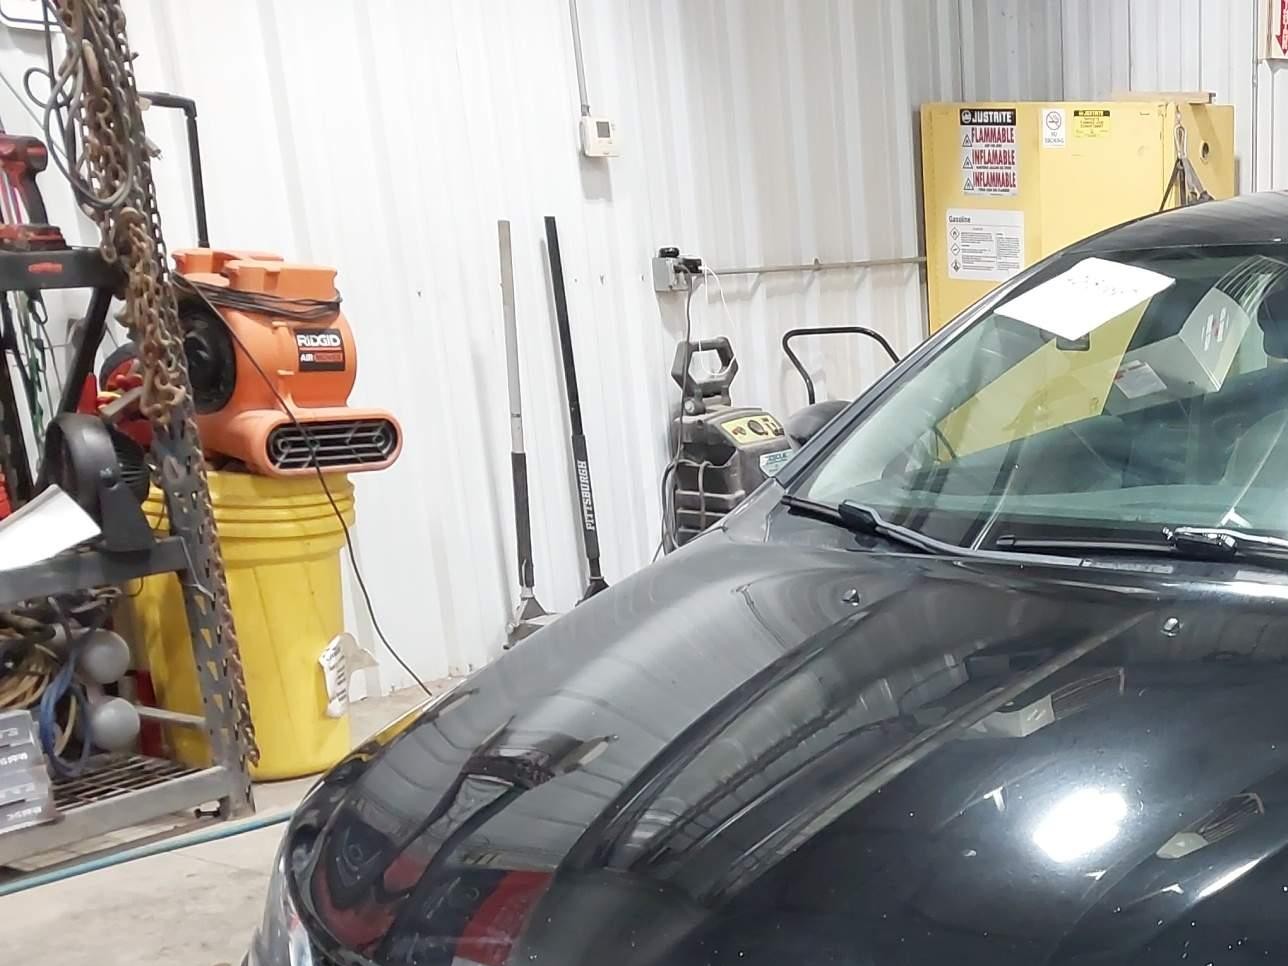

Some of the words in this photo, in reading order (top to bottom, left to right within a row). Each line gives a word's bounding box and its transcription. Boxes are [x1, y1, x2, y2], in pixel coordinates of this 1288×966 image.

[972, 111, 1012, 123] JUSTRITE
[971, 127, 1014, 143] FLAMMABLE
[972, 149, 1015, 165] INFLAMABLE
[973, 171, 1016, 188] INFLAMMABLE
[949, 215, 971, 223] Gasoline
[296, 334, 341, 347] RIDGID
[300, 353, 314, 362] AIR
[577, 459, 595, 531] PITTSBURGH
